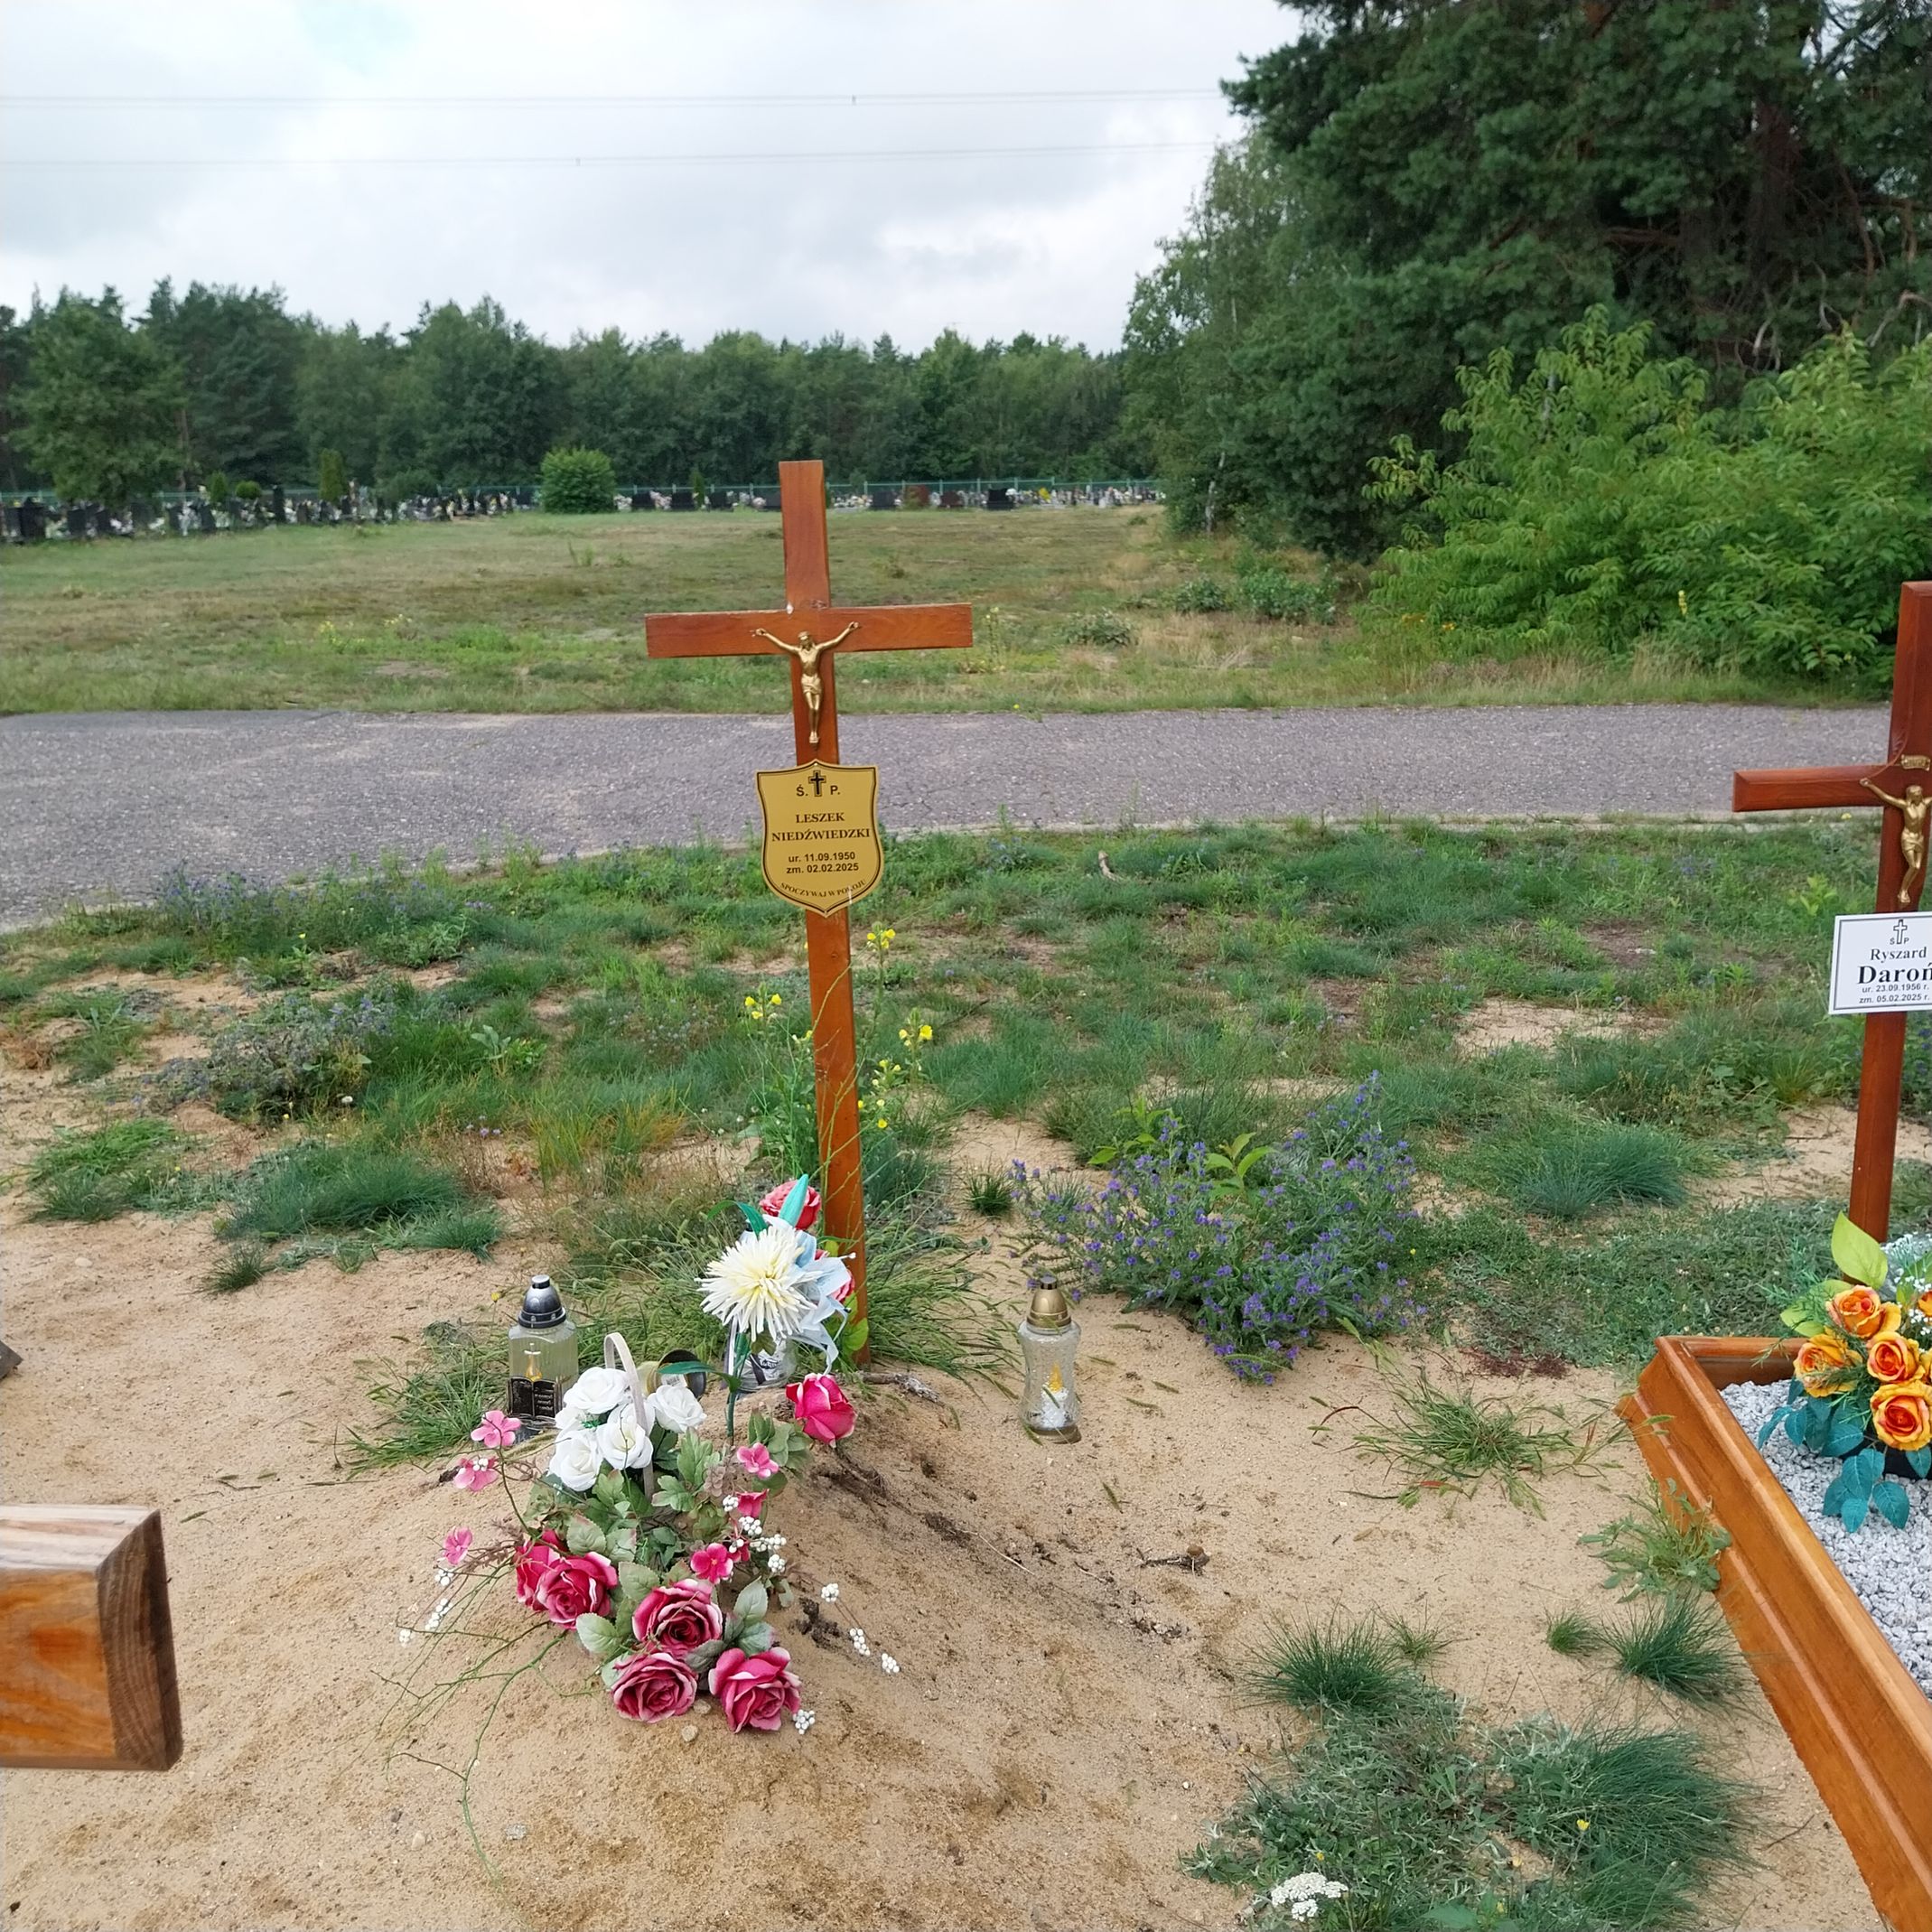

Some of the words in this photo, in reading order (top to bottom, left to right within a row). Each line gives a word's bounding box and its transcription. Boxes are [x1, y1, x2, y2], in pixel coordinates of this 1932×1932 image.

[796, 784, 808, 797] Ś.
[830, 785, 841, 796] P.
[796, 812, 845, 824] LESZEK
[771, 828, 871, 842] NIEDŹWIEDZKI
[788, 854, 801, 863] ur.
[804, 851, 855, 862] 11.09.1950
[786, 865, 804, 874] zm.
[807, 863, 859, 873] 02.02.2025
[780, 882, 826, 898] SPOCZYWAJ
[1871, 946, 1927, 964] Ryszard
[1876, 994, 1922, 1003] 05.02.2025
